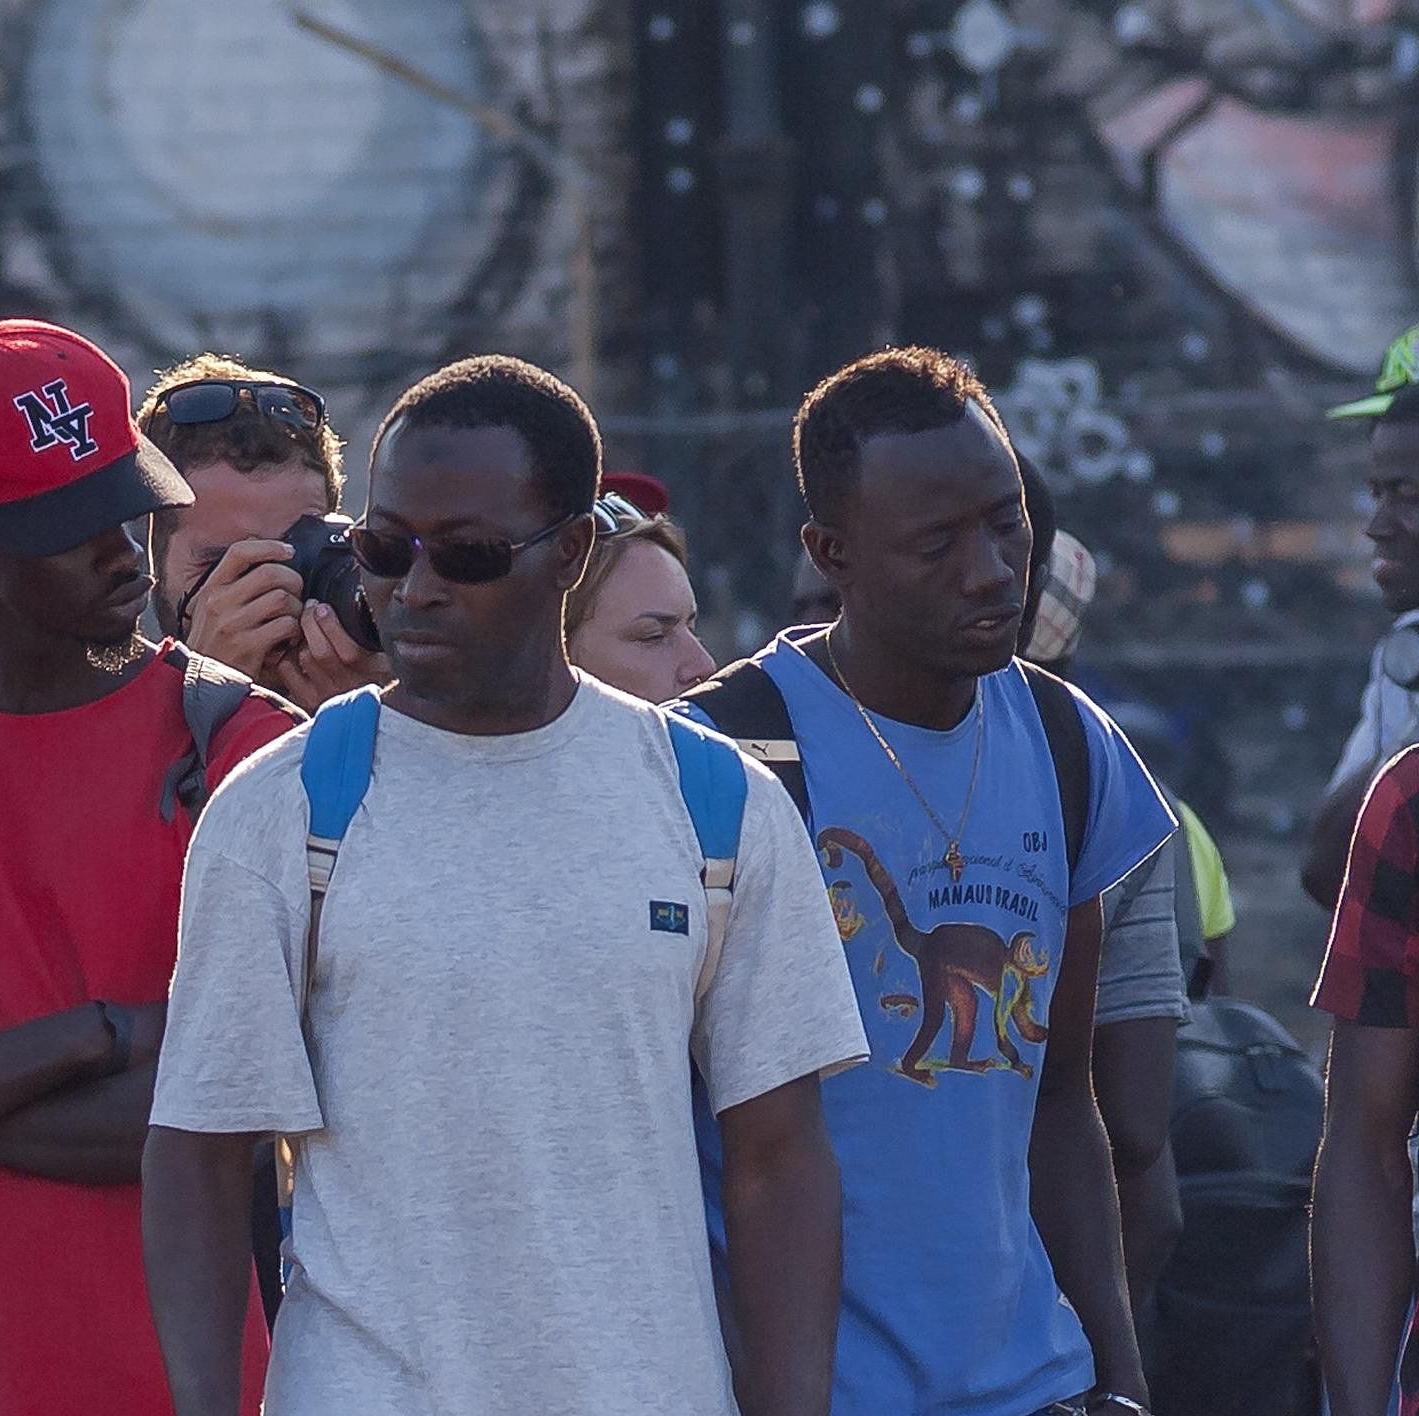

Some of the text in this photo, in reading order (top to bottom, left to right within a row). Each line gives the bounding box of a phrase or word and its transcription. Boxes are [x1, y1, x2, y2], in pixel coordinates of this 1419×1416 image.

[12, 377, 99, 462] NY
[928, 883, 992, 912] MANAUS
[995, 885, 1039, 922] BRASIL
